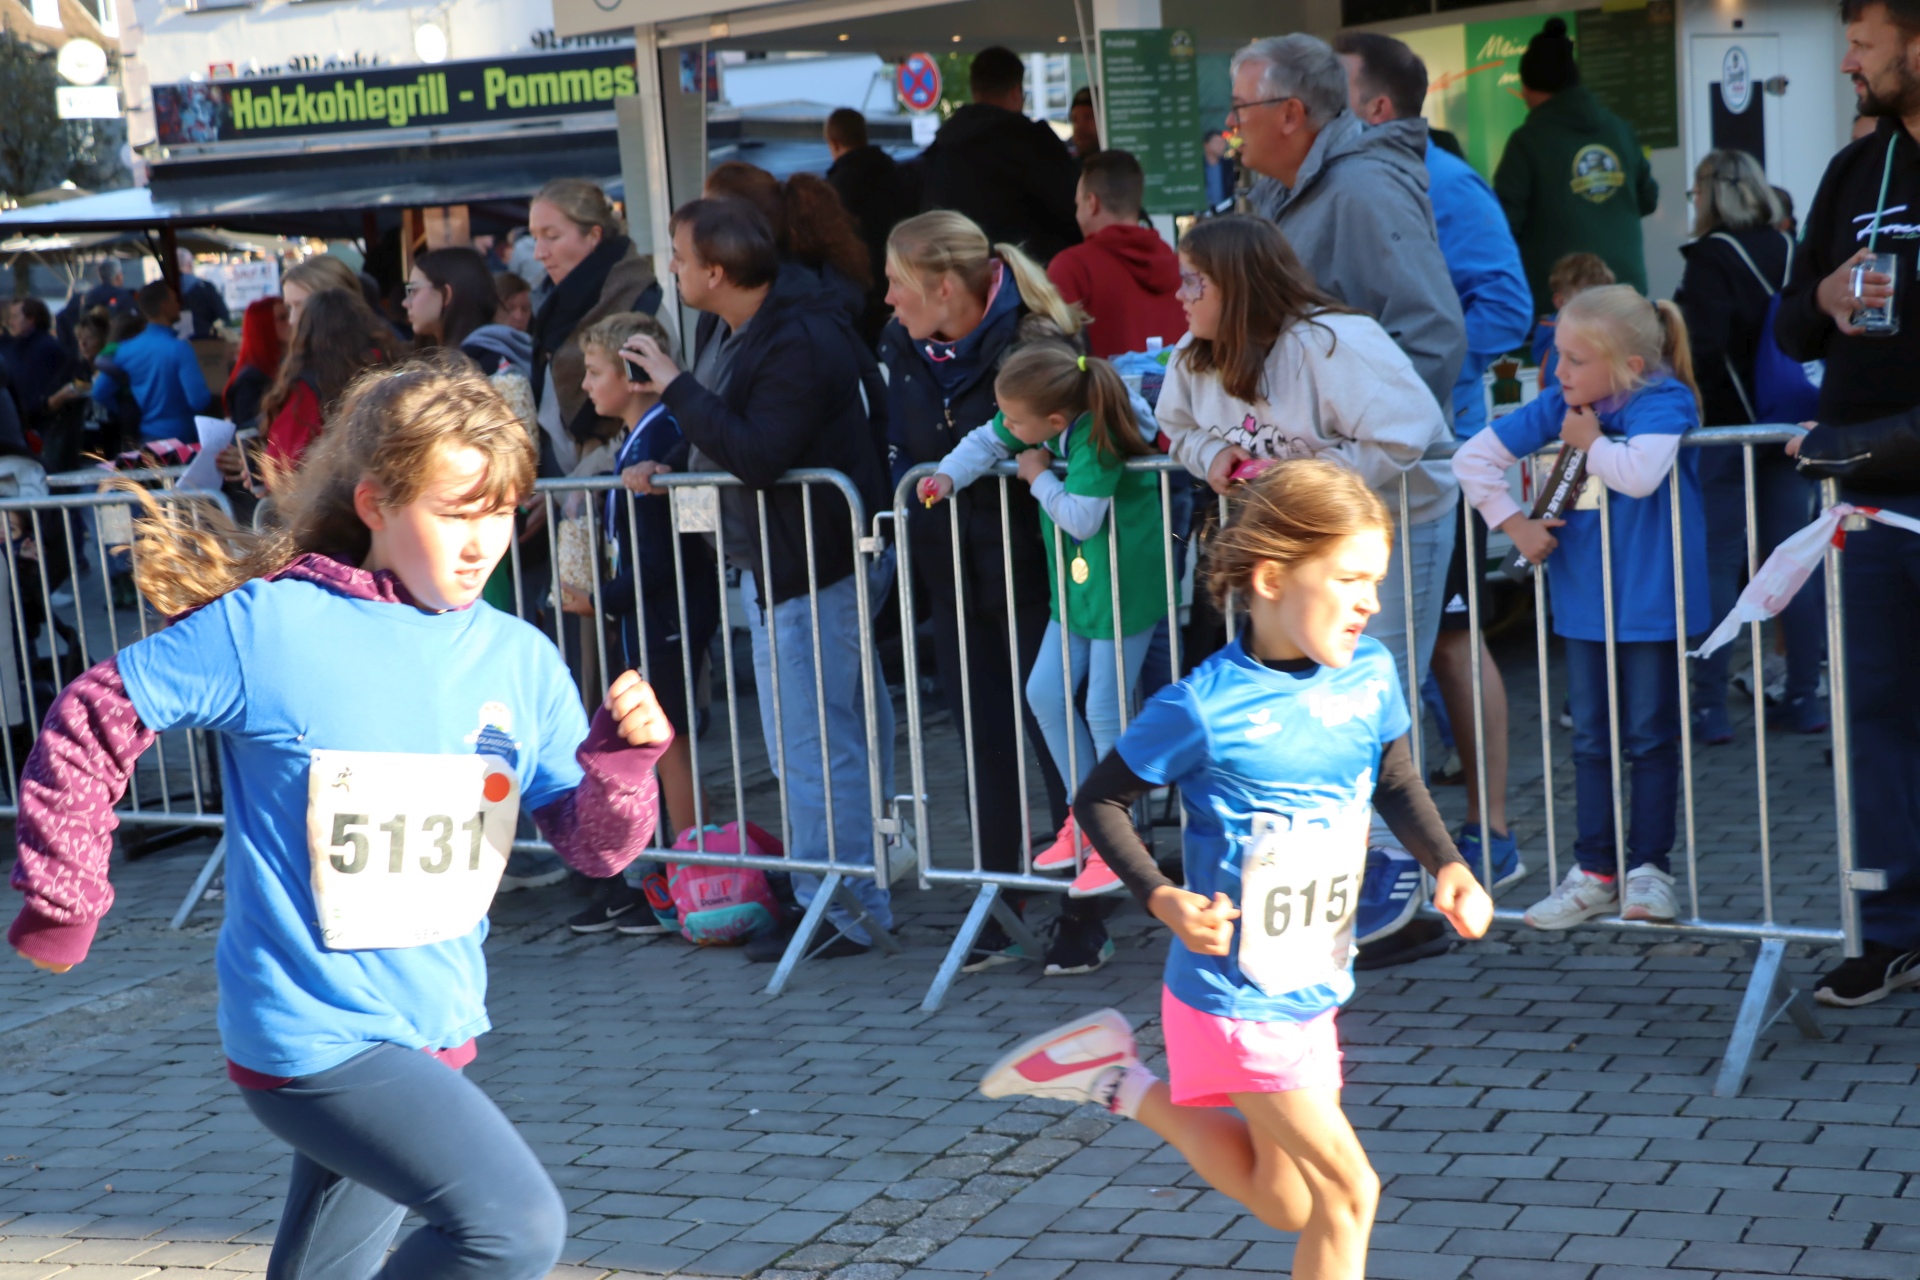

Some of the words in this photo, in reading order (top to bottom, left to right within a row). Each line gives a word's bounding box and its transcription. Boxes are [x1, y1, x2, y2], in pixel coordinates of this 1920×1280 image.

[231, 72, 449, 131] Holzkohlegrill
[459, 90, 474, 101] -
[484, 65, 636, 110] Pommes
[1547, 480, 1571, 514] NEUE
[329, 811, 485, 874] 5131
[698, 879, 732, 899] PUP
[1264, 873, 1360, 937] 615
